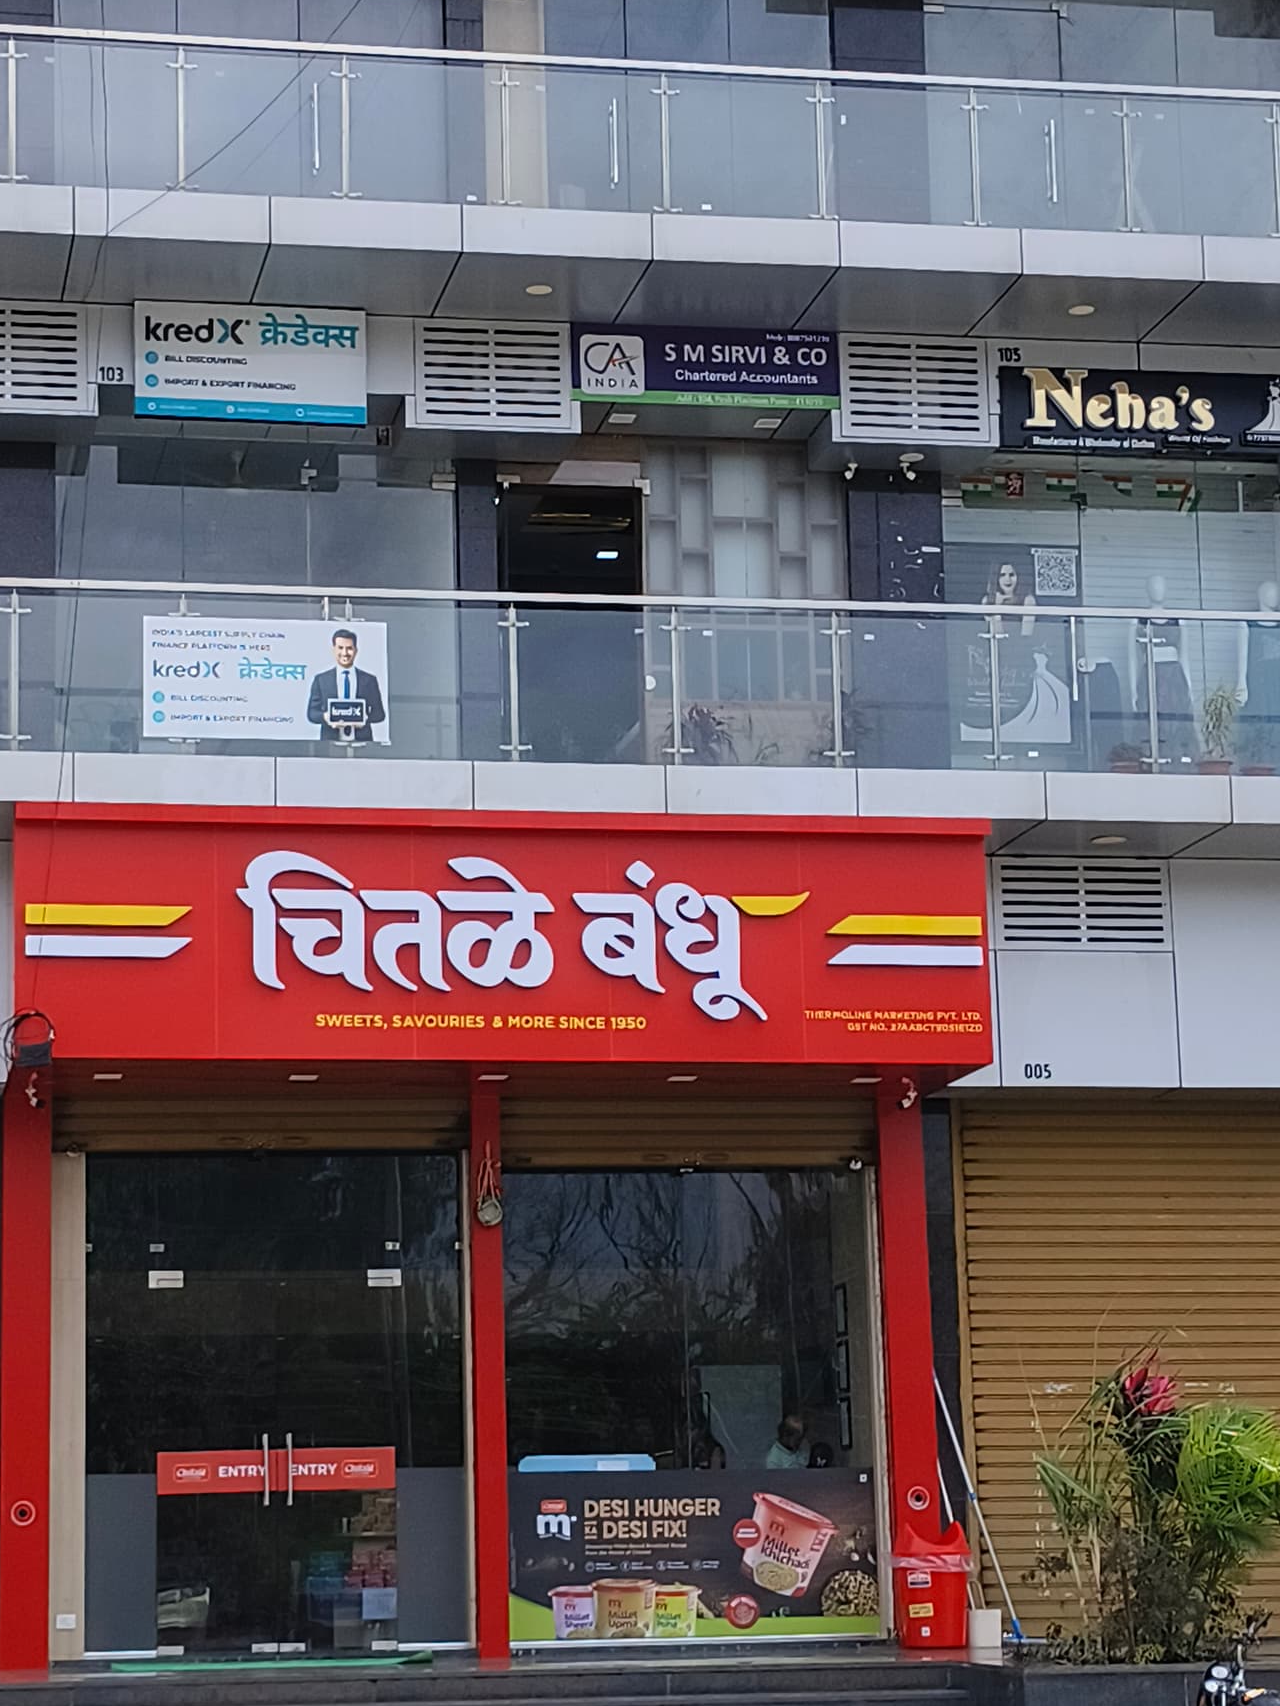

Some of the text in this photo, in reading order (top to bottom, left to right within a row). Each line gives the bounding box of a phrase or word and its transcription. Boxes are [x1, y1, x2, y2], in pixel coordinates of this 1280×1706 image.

[144, 315, 245, 344] kredX
[258, 313, 359, 349] क्रेडेक्स
[186, 356, 247, 365] DISCOUNTING
[584, 342, 637, 376] CA
[664, 343, 827, 366] S M SIRVI & CO
[998, 347, 1021, 363] 105
[98, 366, 124, 383] 103
[587, 377, 639, 389] INDIA
[675, 369, 819, 385] Chartered Accountants
[164, 378, 199, 387] IMPORT
[209, 380, 245, 389] EXPORT
[247, 381, 296, 391] FINANCING
[1022, 367, 1216, 432] Neha's
[152, 659, 221, 678] kredX
[238, 657, 308, 680] क्रेडेक्स
[235, 849, 770, 1023] चितळे बंधू
[315, 1013, 647, 1030] SWEETS, SAVOURIES & MORE SINCE 1950
[874, 1011, 934, 1021] MARKETING
[936, 1011, 959, 1021] PVT.
[961, 1012, 983, 1021] LTD.
[847, 1022, 867, 1032] GST
[869, 1022, 888, 1032] NO.
[1023, 1061, 1053, 1079] 005
[218, 1463, 266, 1478] ENTRY
[290, 1463, 337, 1476] ENTRY
[584, 1499, 629, 1518] DESI
[634, 1498, 720, 1517] HUNGER
[602, 1520, 648, 1539] DESI
[652, 1520, 688, 1538] FIX!
[763, 1534, 801, 1557] Millet
